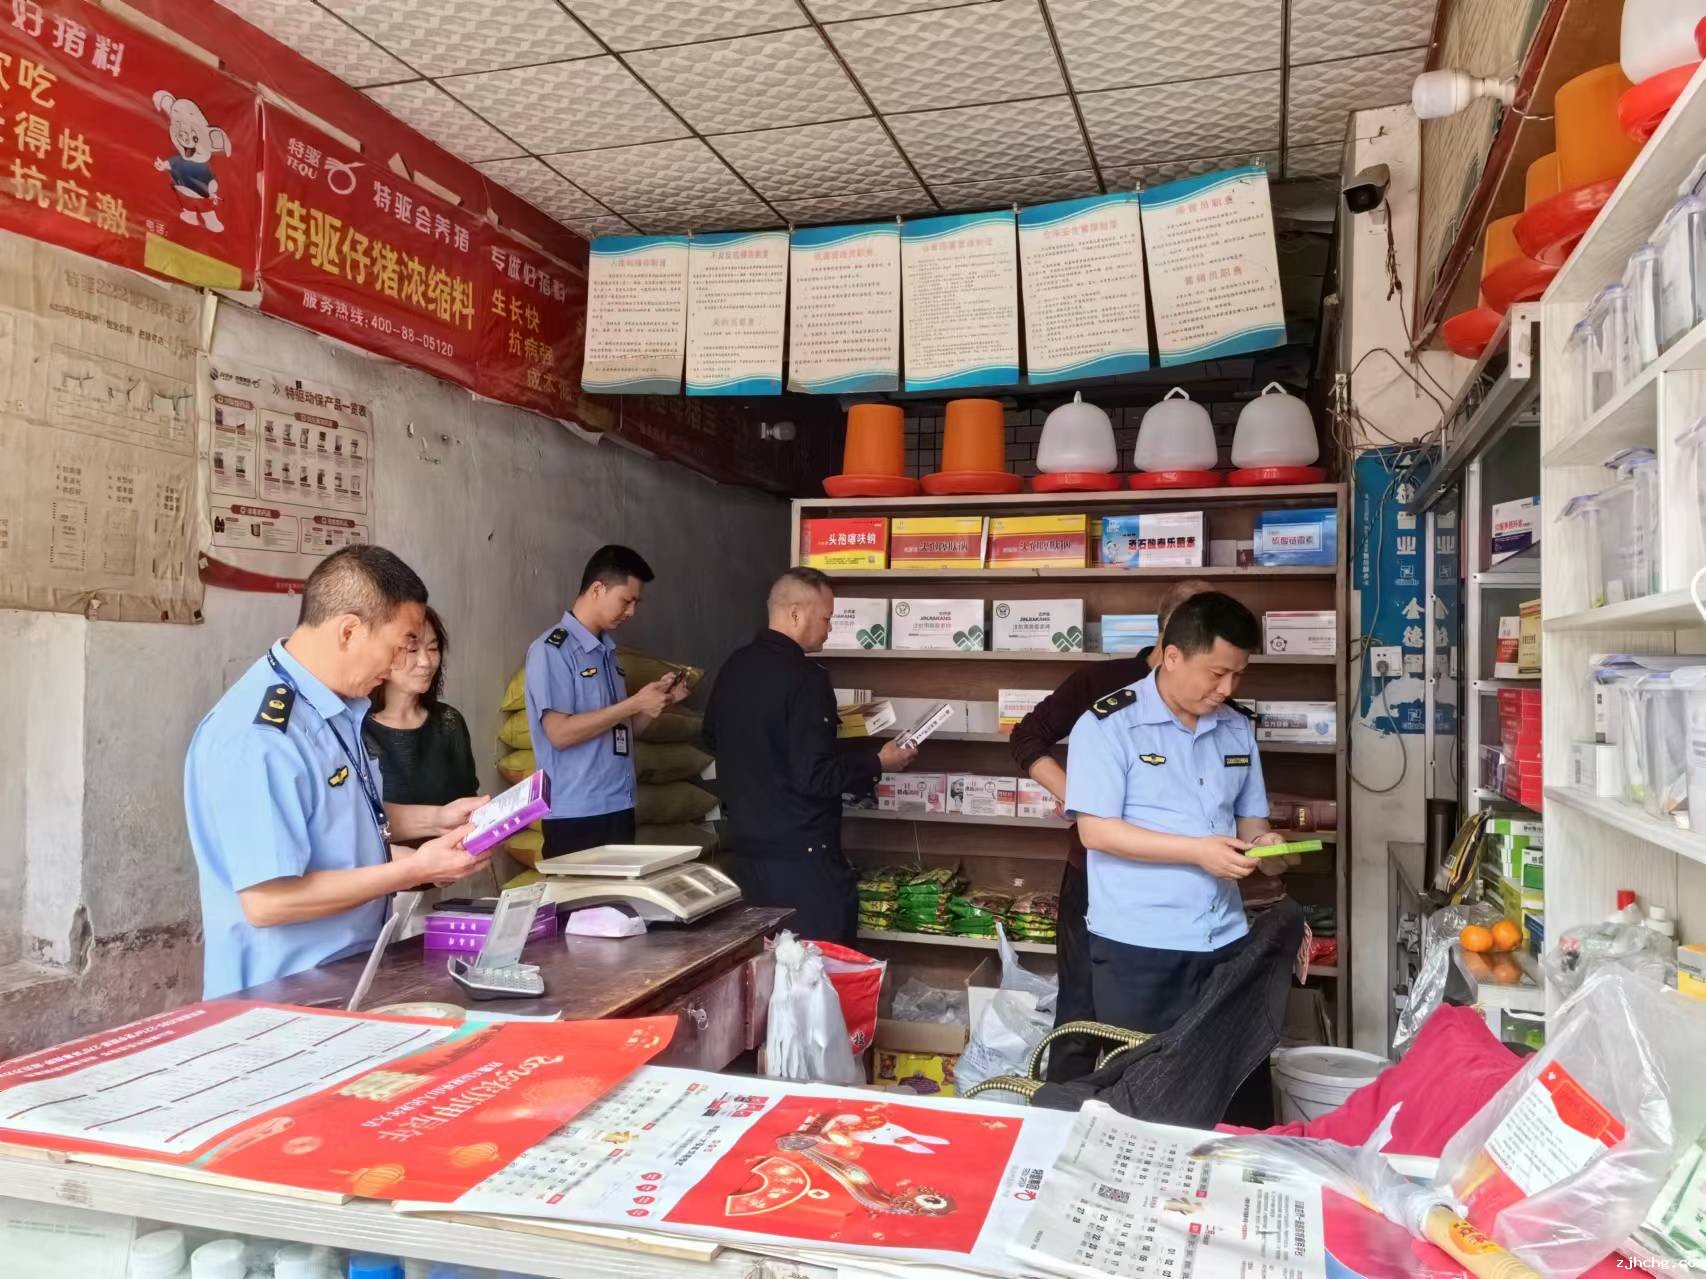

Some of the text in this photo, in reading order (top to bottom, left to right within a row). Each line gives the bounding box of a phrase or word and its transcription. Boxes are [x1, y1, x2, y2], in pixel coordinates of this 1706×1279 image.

[11, 0, 125, 77] 好猪料
[286, 155, 318, 179] TEQU
[288, 137, 321, 166] 特驱
[10, 159, 129, 238] 抗应激
[274, 192, 476, 331] 特驱仔猪浓缩料
[373, 180, 566, 304] 特驱会养猪 专做好猪料
[491, 288, 540, 333] 生长快
[508, 328, 554, 366] 抗病强
[285, 384, 368, 418] 特驱动保产品一览表
